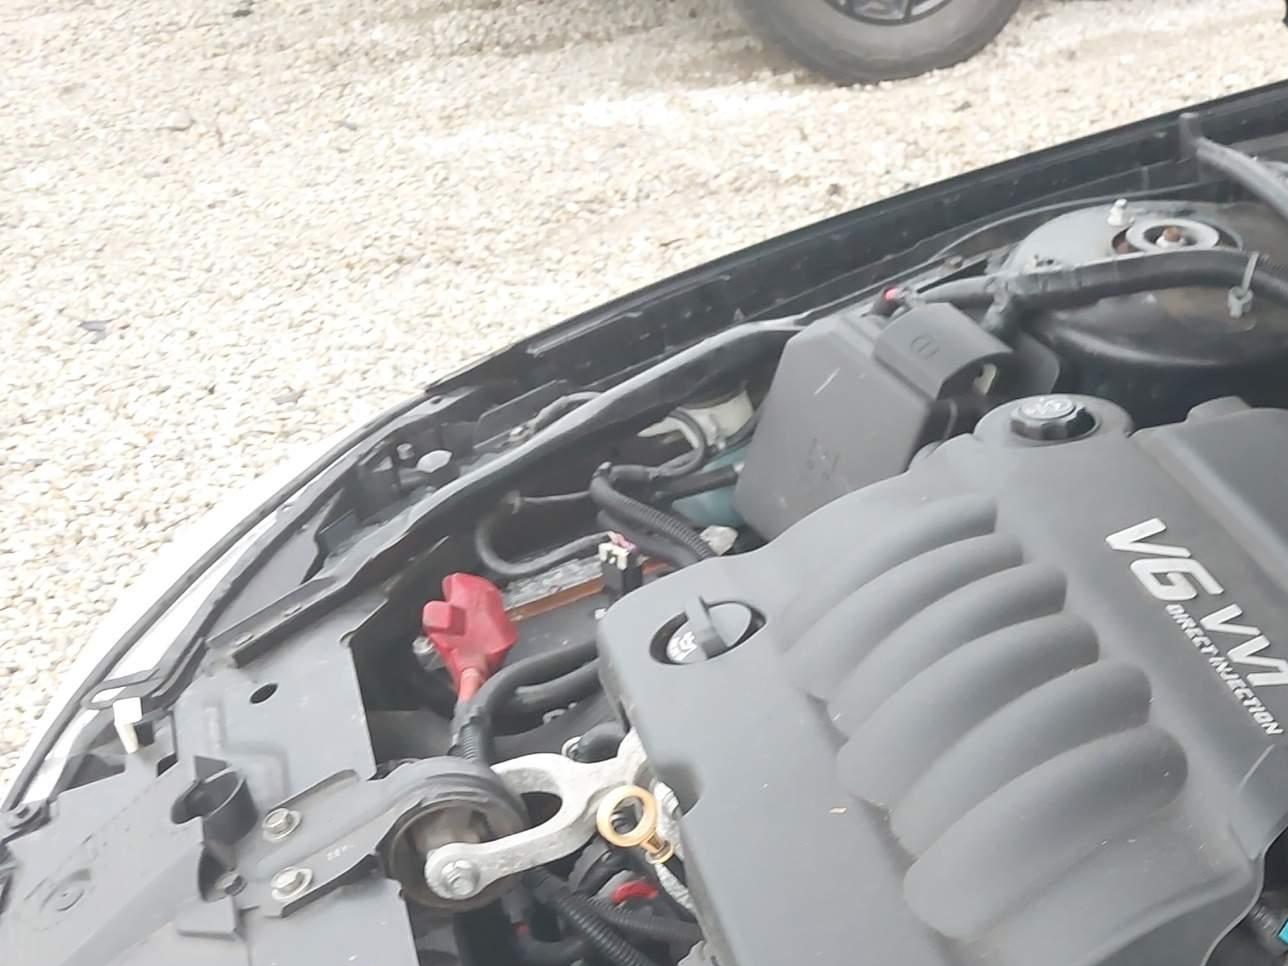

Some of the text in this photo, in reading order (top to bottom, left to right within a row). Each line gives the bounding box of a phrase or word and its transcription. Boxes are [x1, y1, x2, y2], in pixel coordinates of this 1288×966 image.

[1105, 517, 1224, 601] V6
[1166, 603, 1284, 735] DIRECT INJECTION
